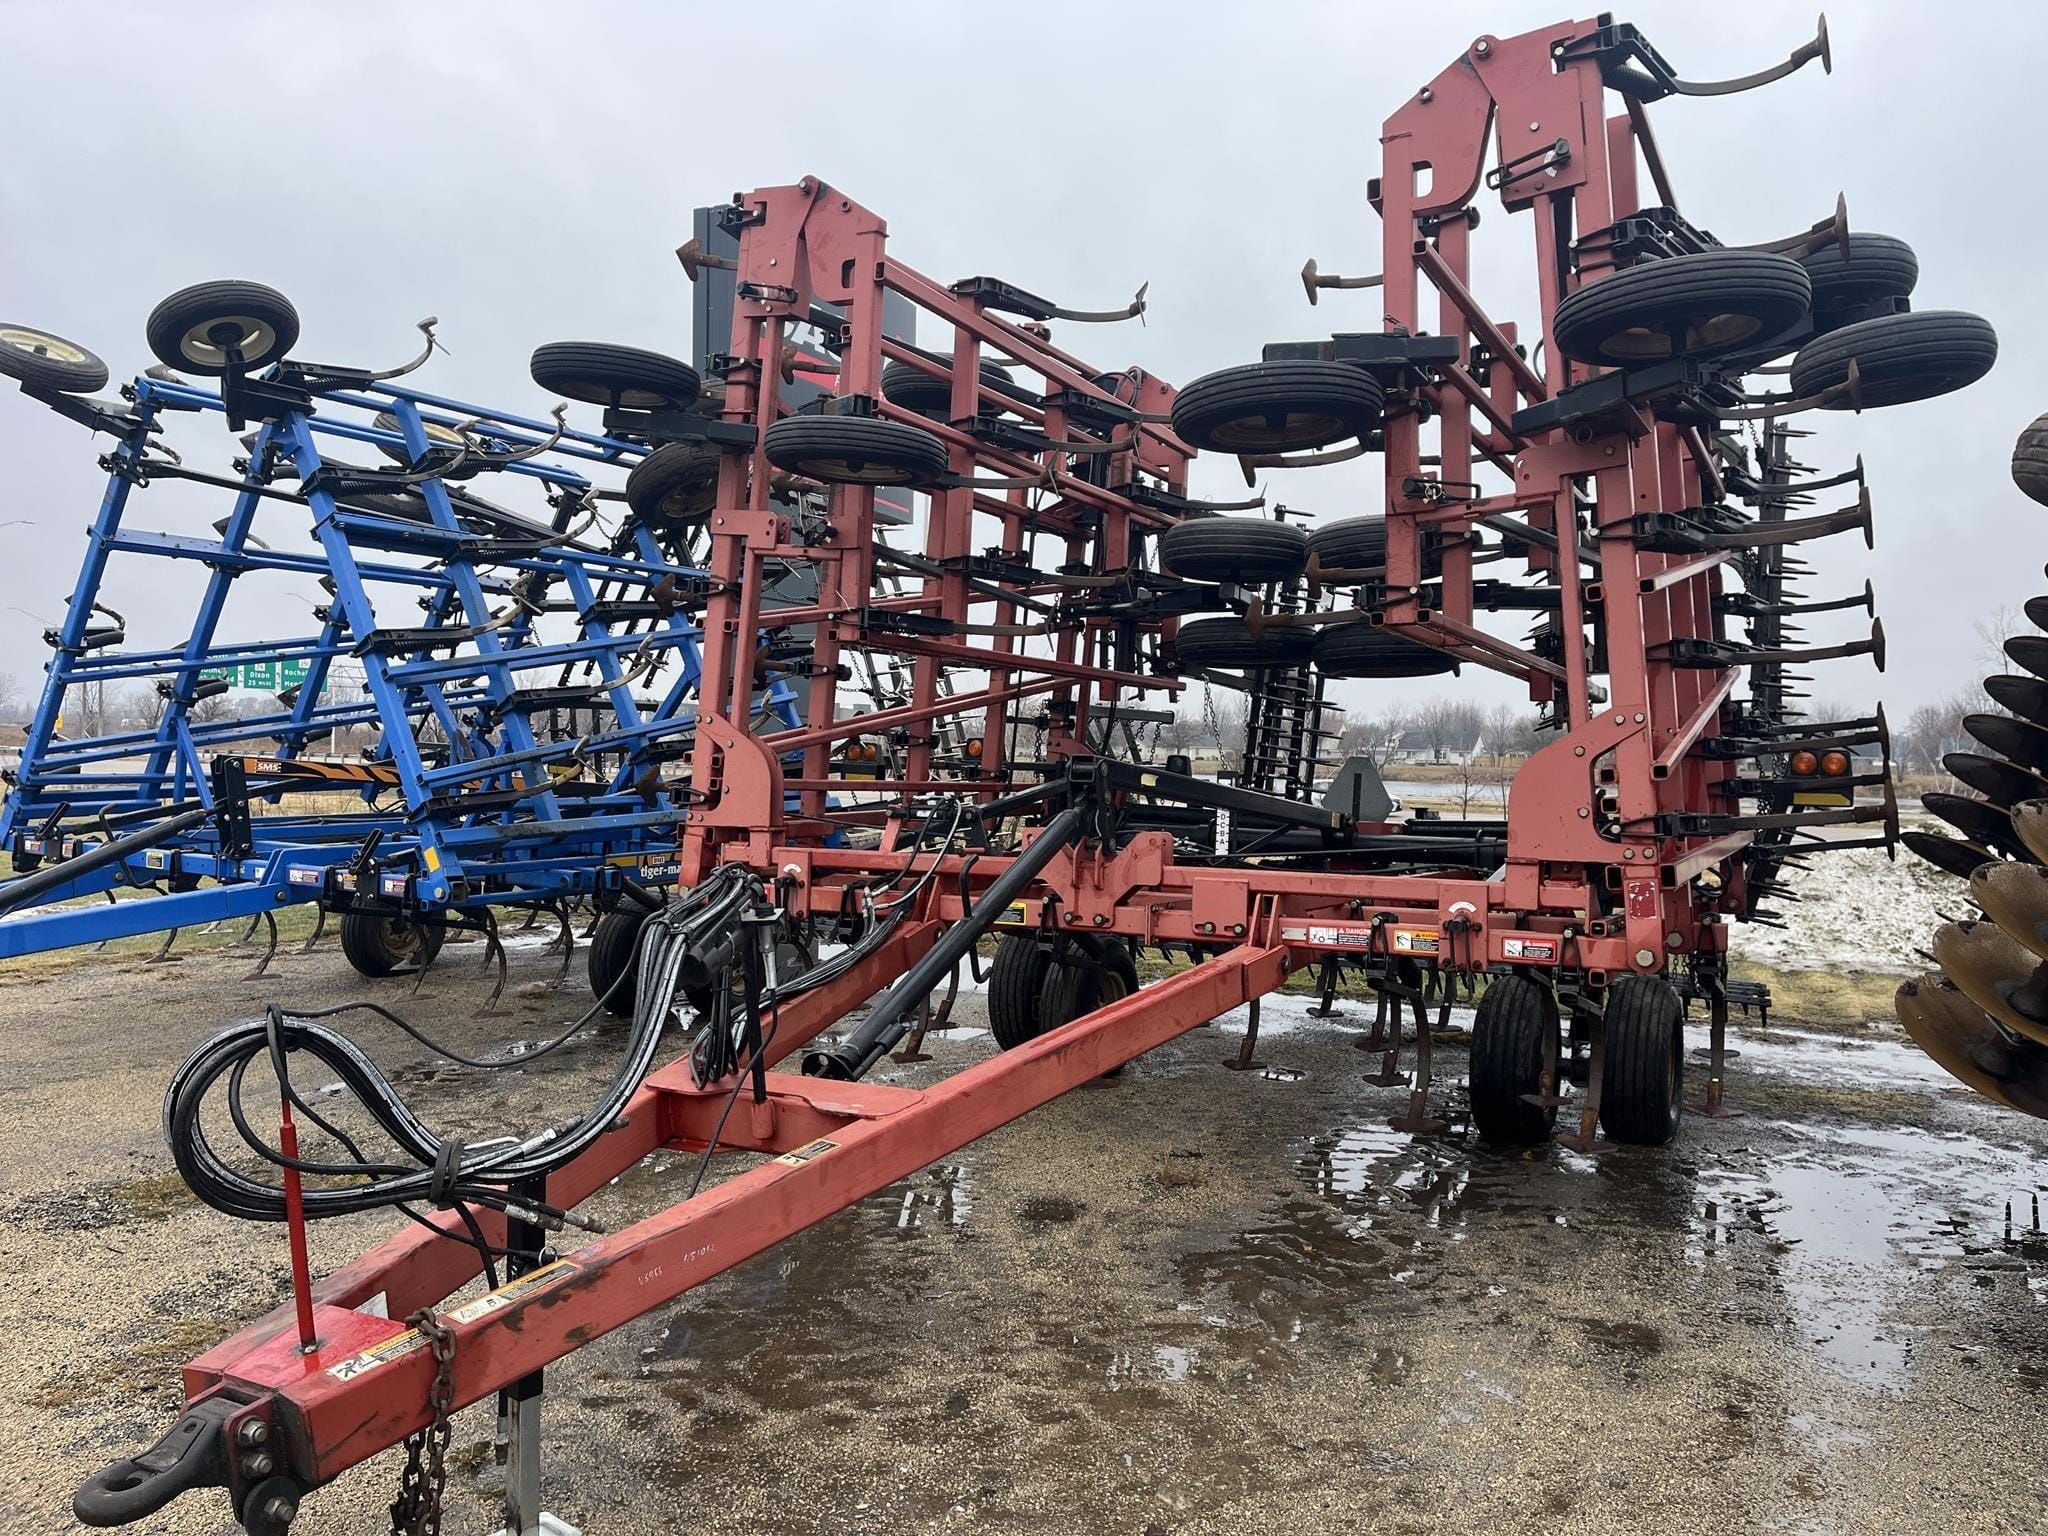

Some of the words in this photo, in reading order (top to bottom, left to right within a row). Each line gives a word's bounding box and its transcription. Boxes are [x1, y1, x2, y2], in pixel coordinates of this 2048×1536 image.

[284, 669, 308, 677] Rochel
[1220, 821, 1226, 829] C
[640, 865, 681, 879] tiger-ma
